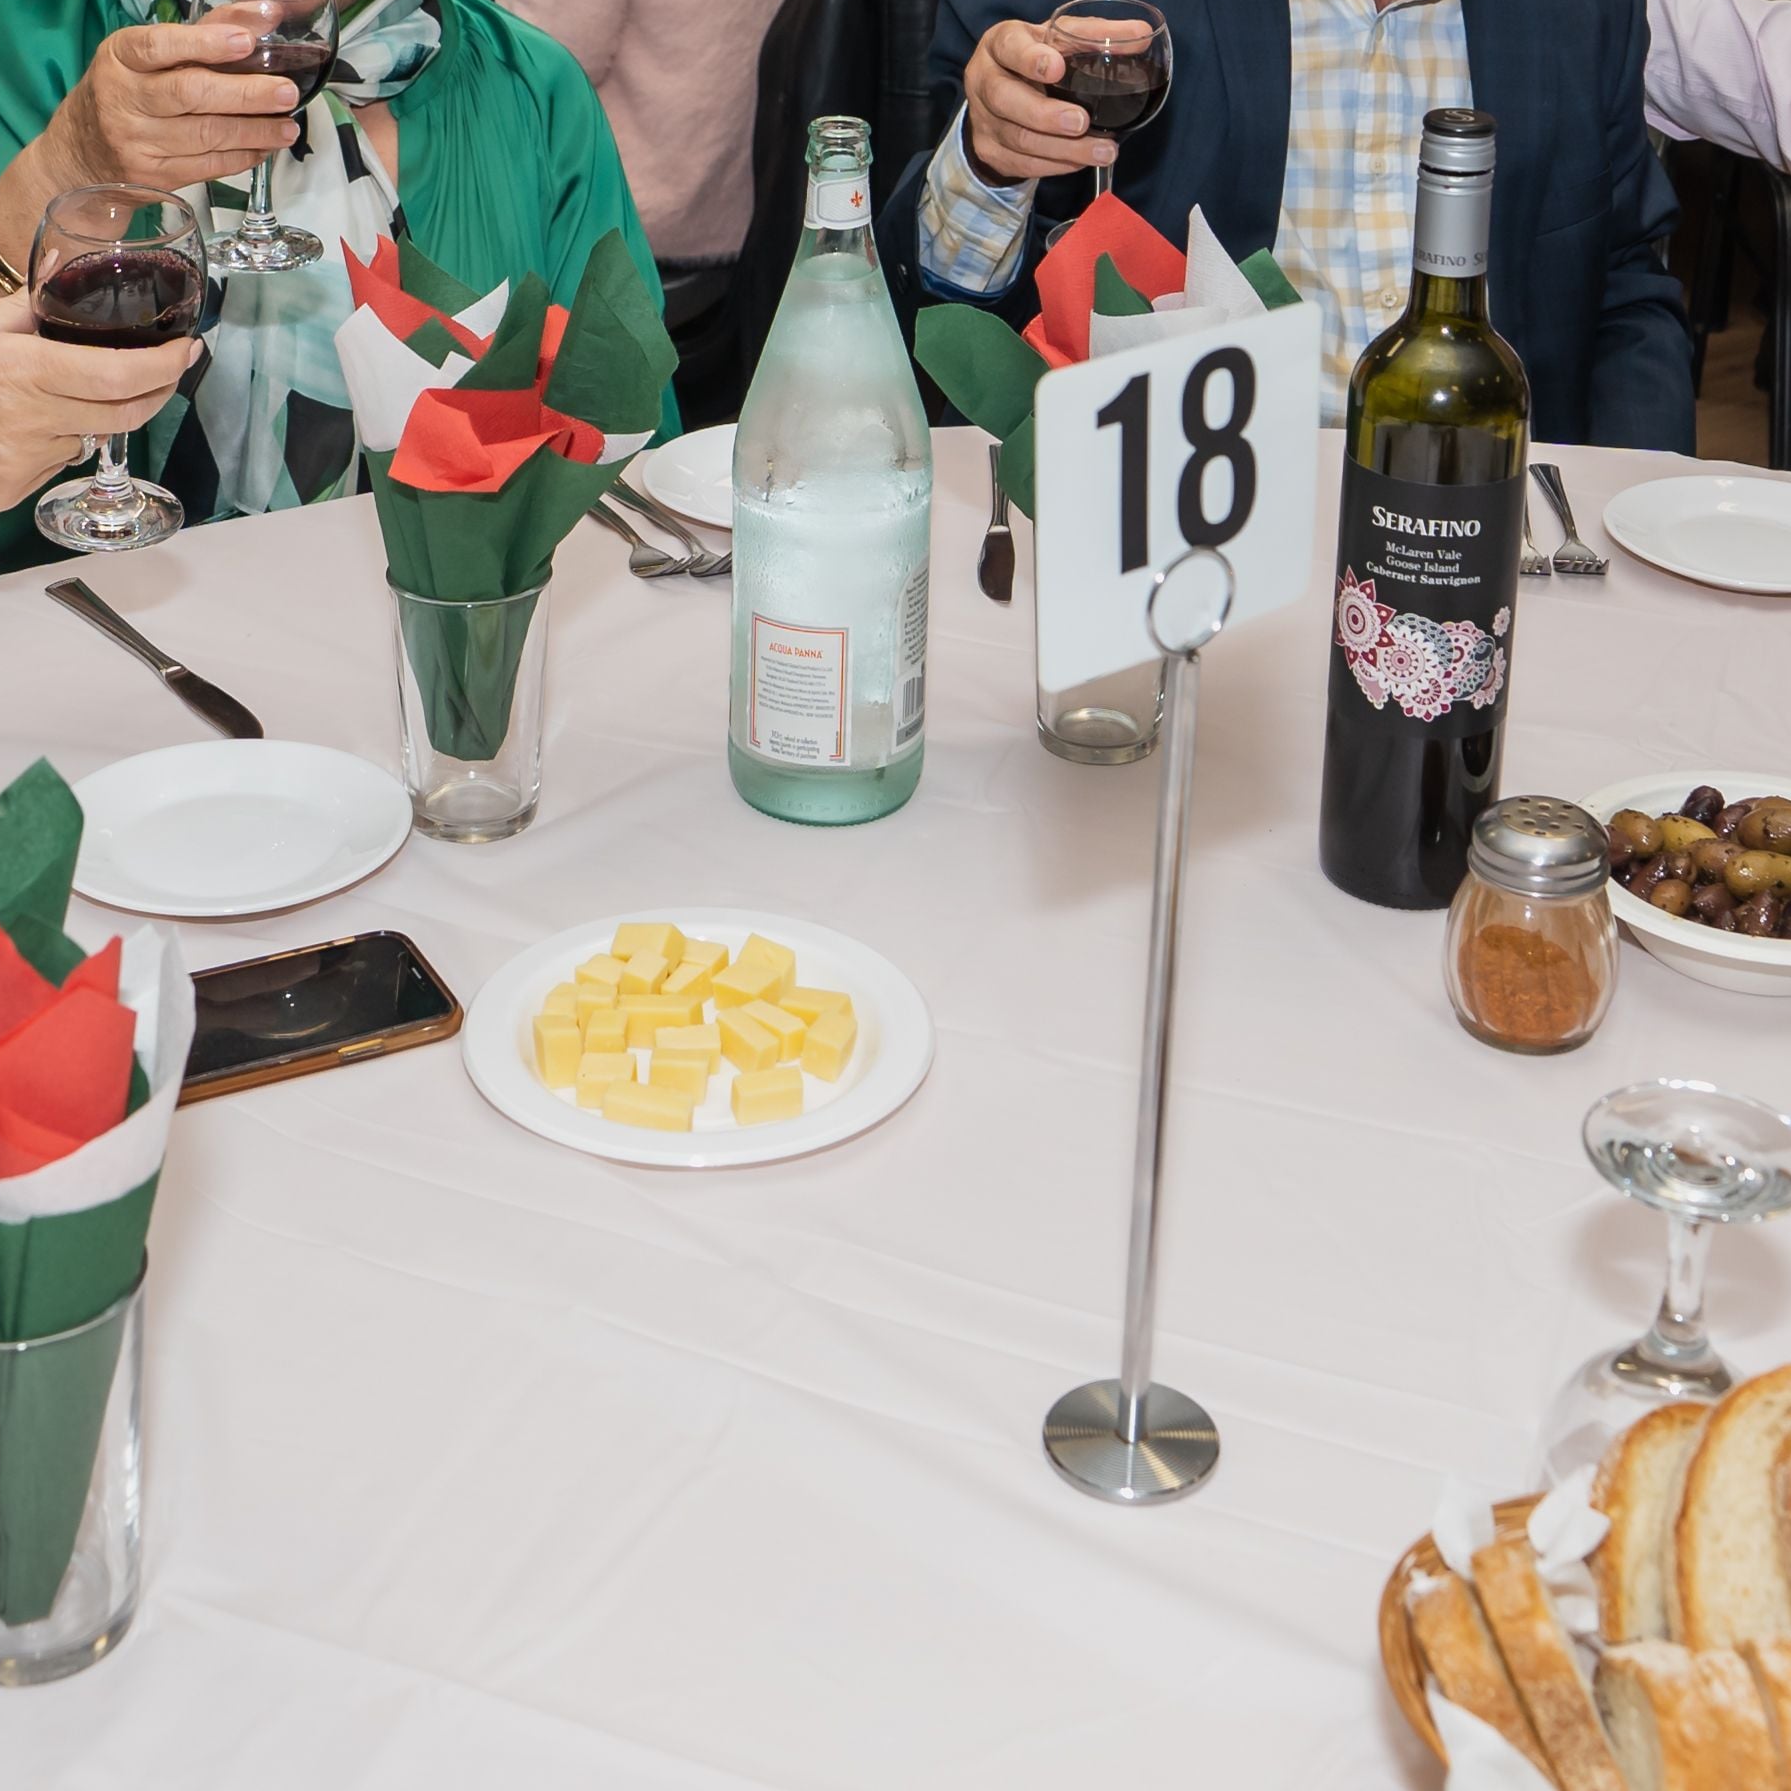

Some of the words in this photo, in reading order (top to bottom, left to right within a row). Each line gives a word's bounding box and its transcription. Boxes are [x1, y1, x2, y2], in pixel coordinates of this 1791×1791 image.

[1416, 248, 1467, 267] RAFINO
[1097, 346, 1257, 575] 18
[1386, 541, 1434, 560] McLaren
[1437, 549, 1462, 560] Vale
[1386, 555, 1421, 571] Goose
[1424, 561, 1460, 573] Island
[1366, 561, 1416, 584] Cabernet
[1420, 572, 1481, 587] Sauvignon
[769, 642, 793, 656] ACQUA
[795, 648, 823, 660] PANNA
